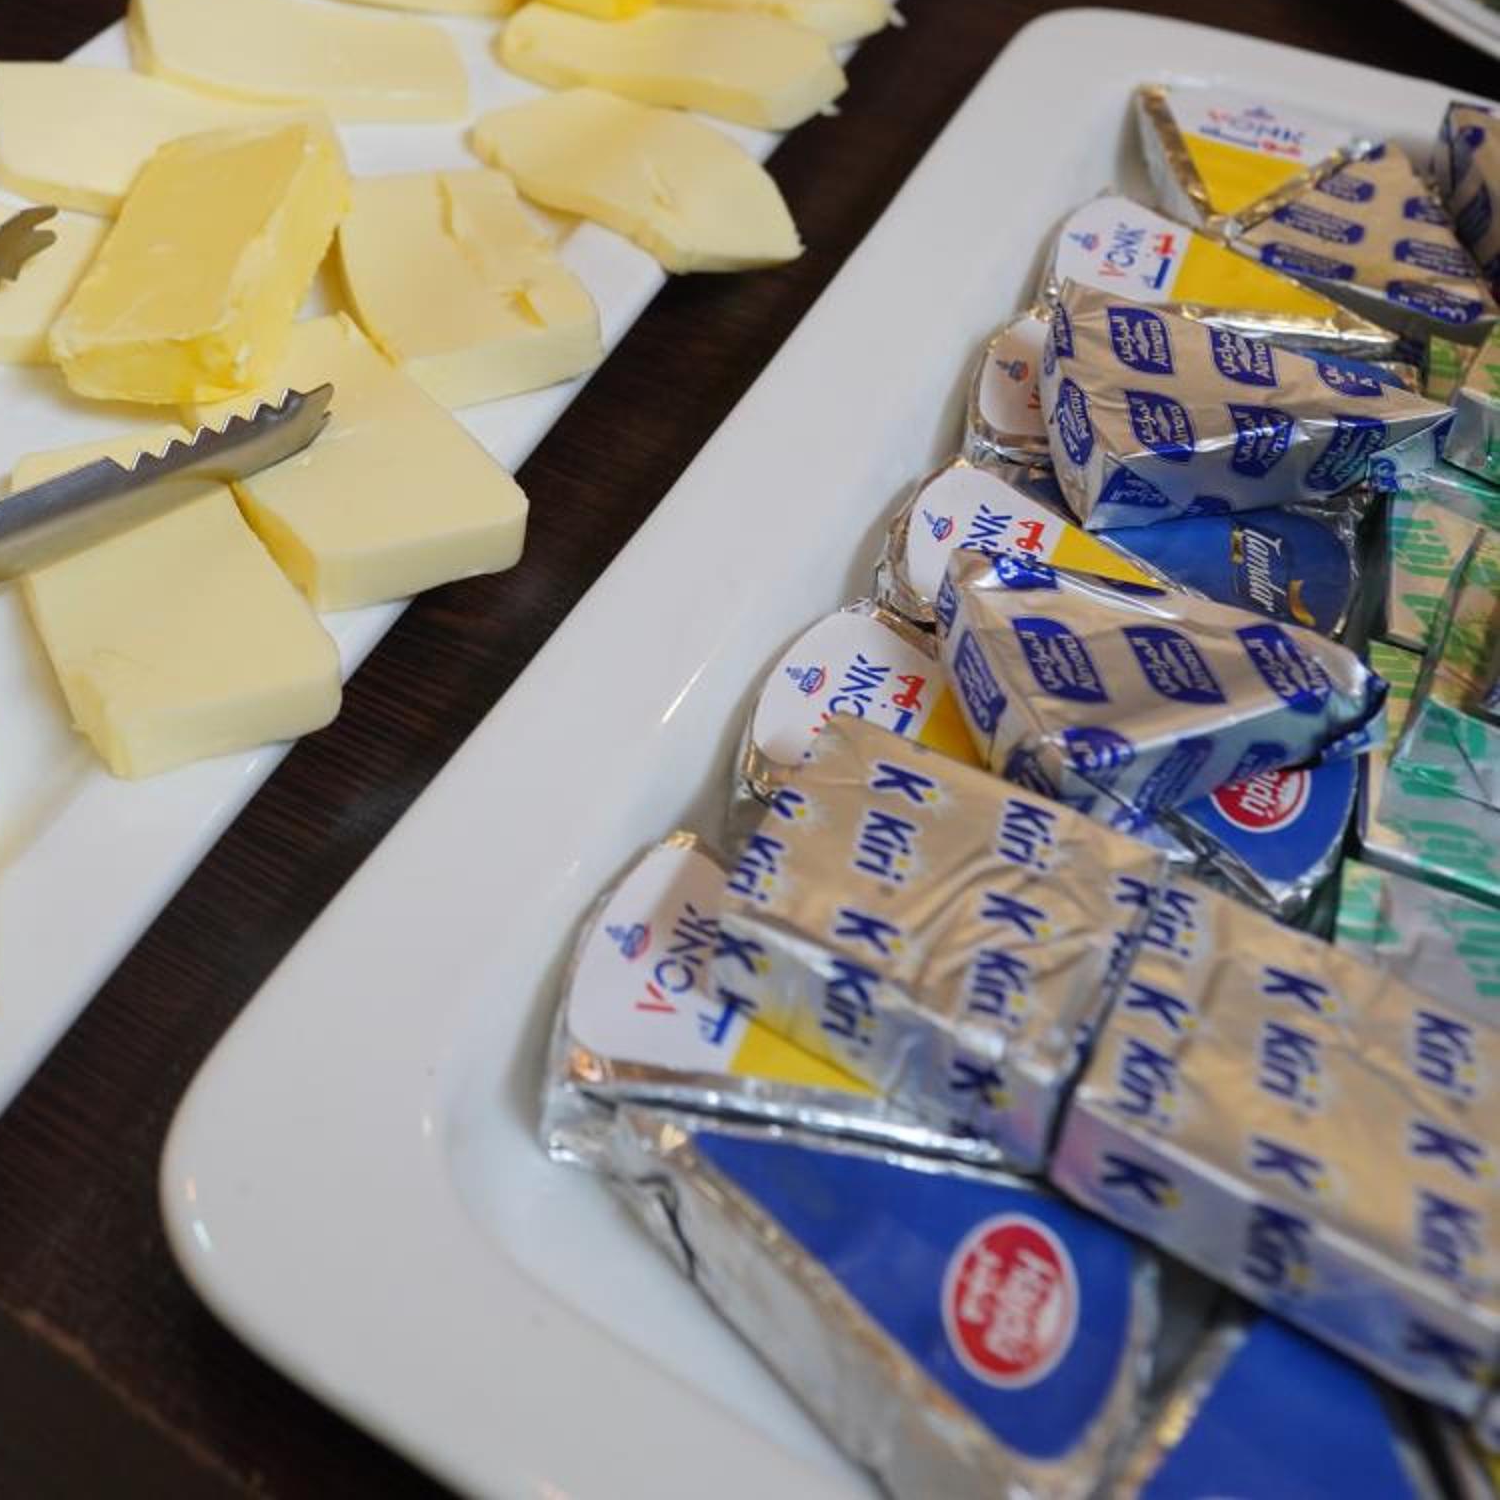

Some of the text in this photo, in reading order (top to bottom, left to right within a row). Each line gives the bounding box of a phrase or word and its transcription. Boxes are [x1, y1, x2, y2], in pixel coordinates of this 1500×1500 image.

[812, 654, 891, 734] ONK
[872, 763, 936, 804] K
[728, 834, 785, 903] Kiri
[854, 809, 918, 883] Kiri
[999, 800, 1057, 872] Kiri
[835, 908, 902, 955] K
[981, 891, 1048, 938] K
[821, 958, 882, 1047] Kiri
[968, 949, 1029, 1027] Kiri
[1125, 981, 1189, 1031] K
[1262, 965, 1329, 1013] K
[1116, 1037, 1178, 1125] Kiri
[1260, 1020, 1319, 1108] Kiri
[1414, 1010, 1475, 1097] Kiri
[1250, 1136, 1323, 1192] K
[1411, 1121, 1484, 1180] K
